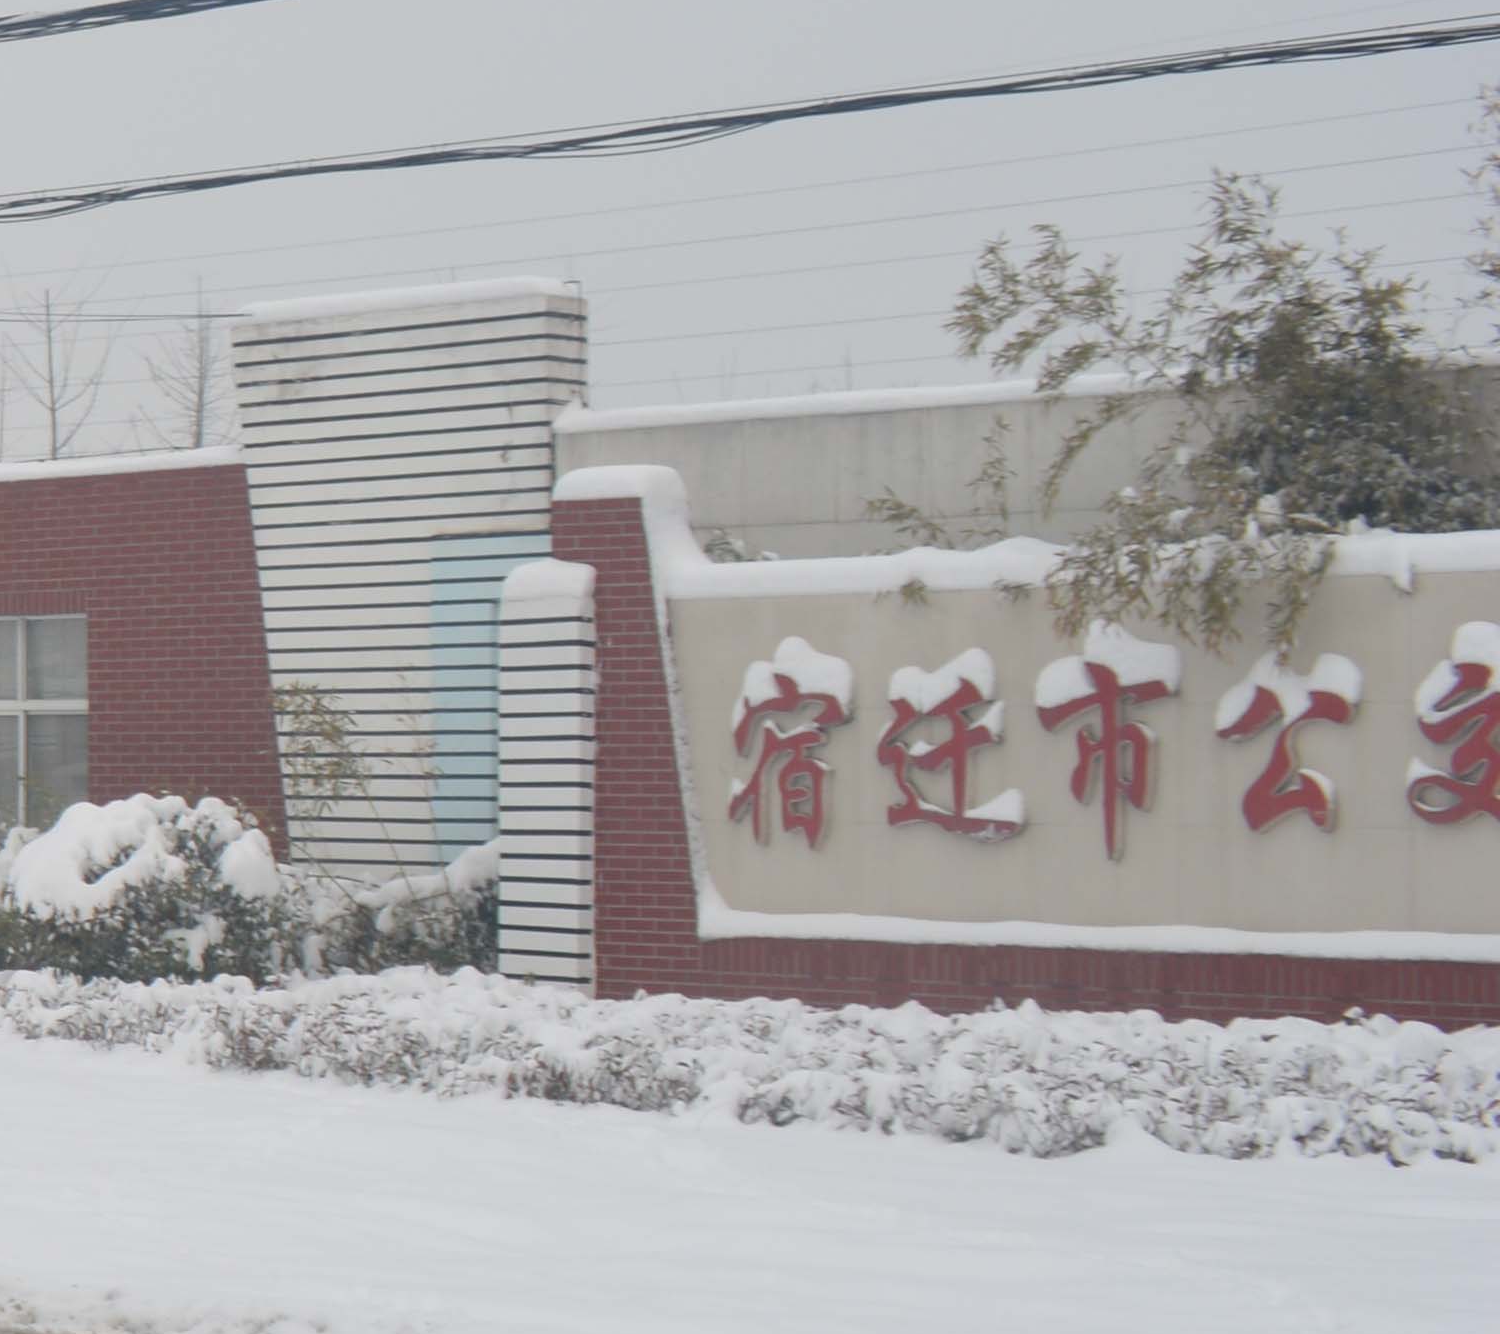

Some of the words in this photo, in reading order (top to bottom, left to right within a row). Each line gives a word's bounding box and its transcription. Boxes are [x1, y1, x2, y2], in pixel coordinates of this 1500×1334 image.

[728, 655, 1500, 861] 宿迁市公交
